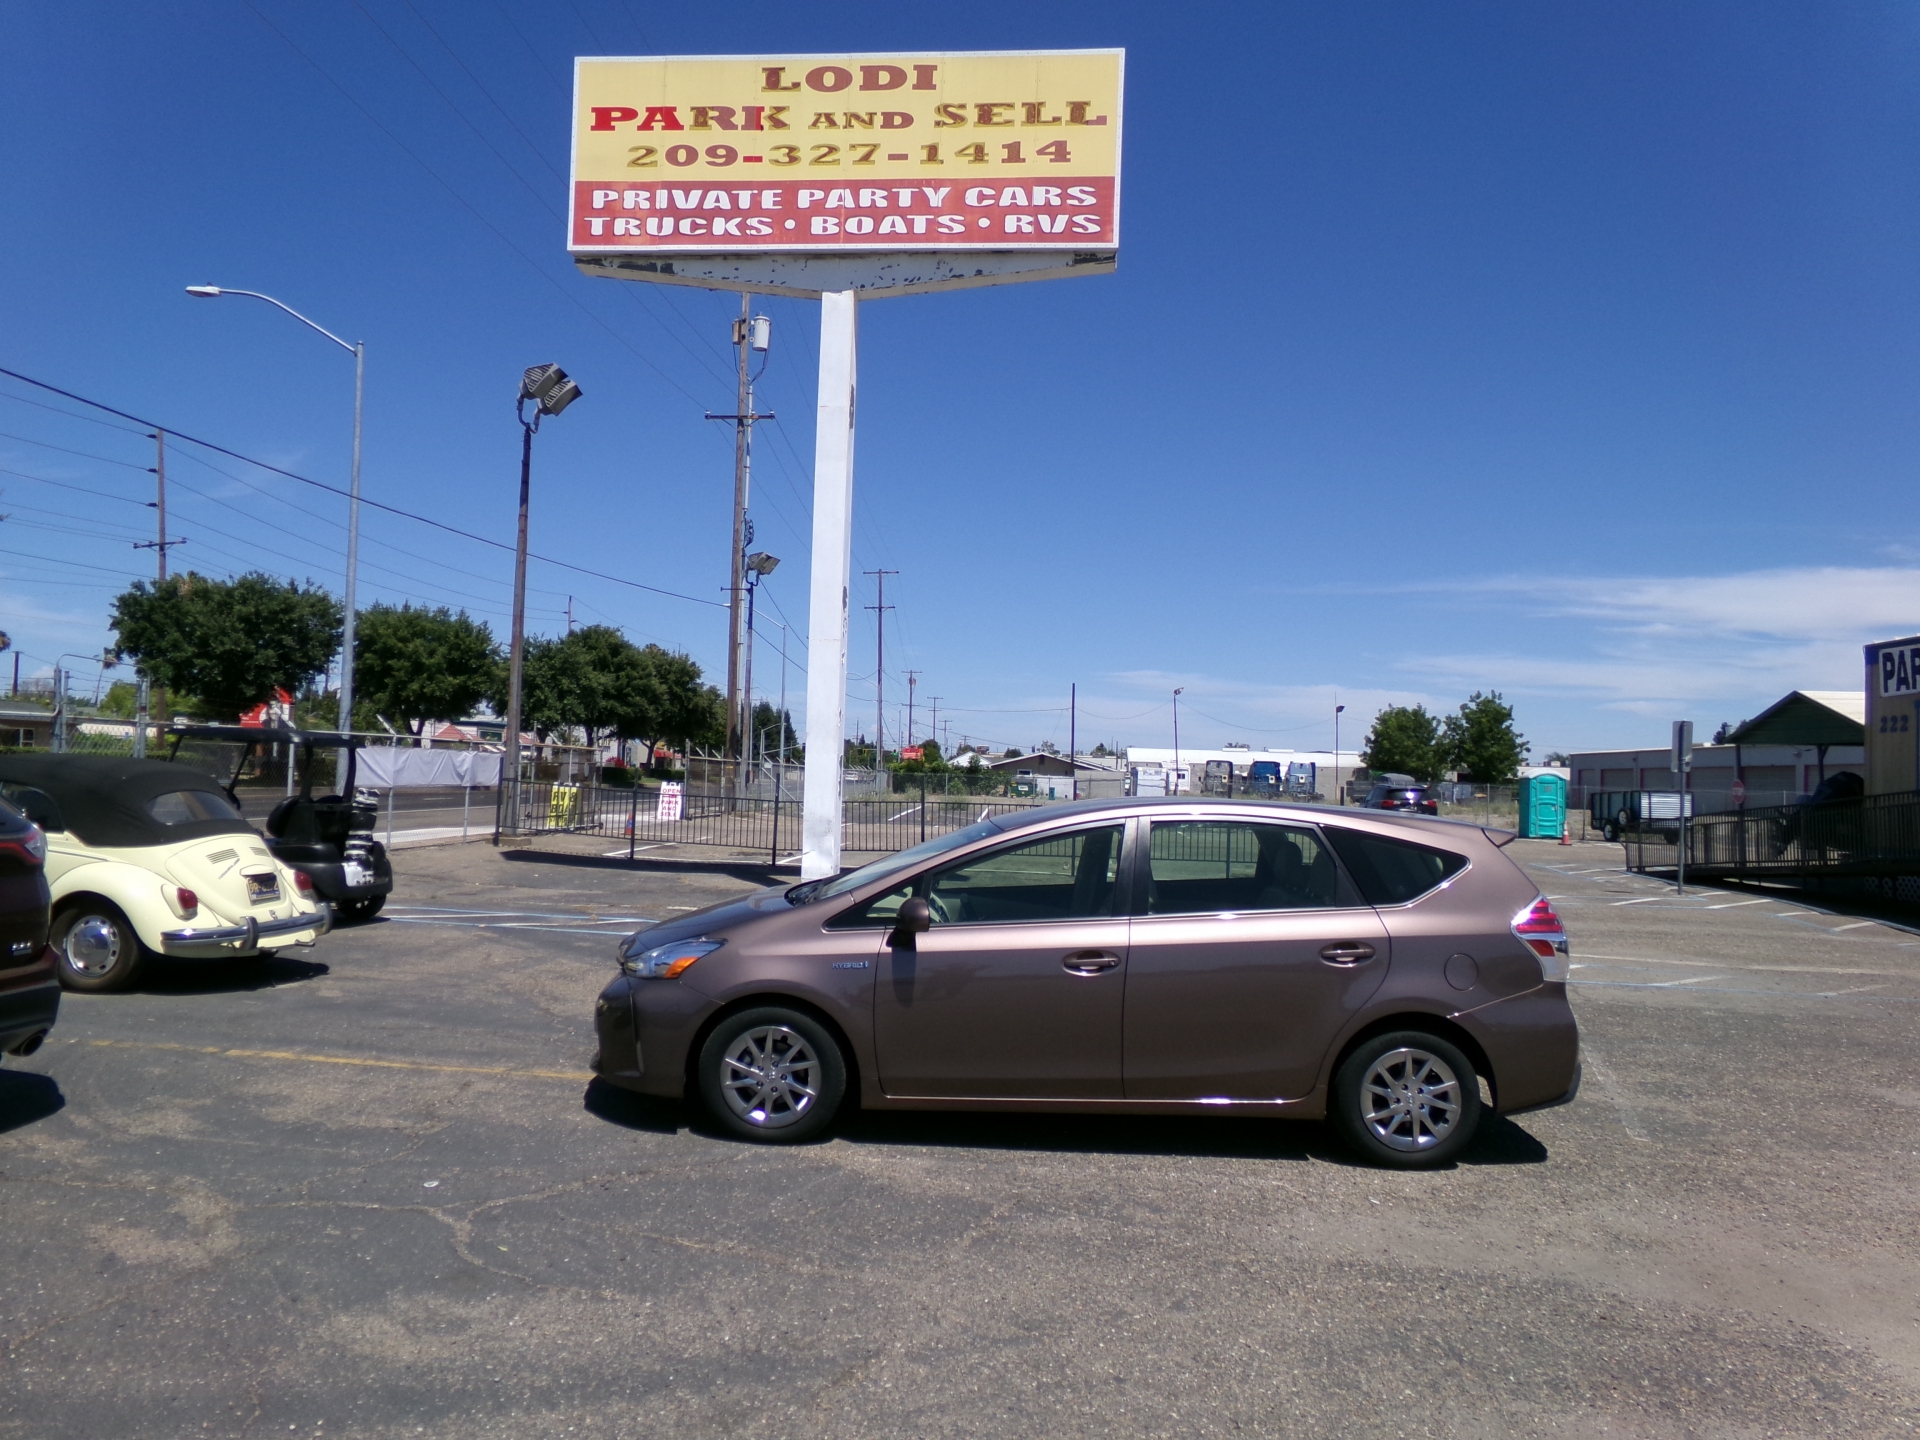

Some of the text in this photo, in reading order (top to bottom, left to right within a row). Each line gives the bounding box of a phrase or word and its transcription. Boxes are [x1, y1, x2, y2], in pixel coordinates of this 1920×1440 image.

[761, 64, 938, 92] LODI
[590, 101, 1108, 131] PARK AND SELL
[627, 140, 1071, 168] 209-327-1414
[592, 186, 1098, 210] PRIVATE PARTY CARS
[584, 215, 1102, 236] TRUCKS BOATS RVS
[1880, 715, 1908, 733] 222
